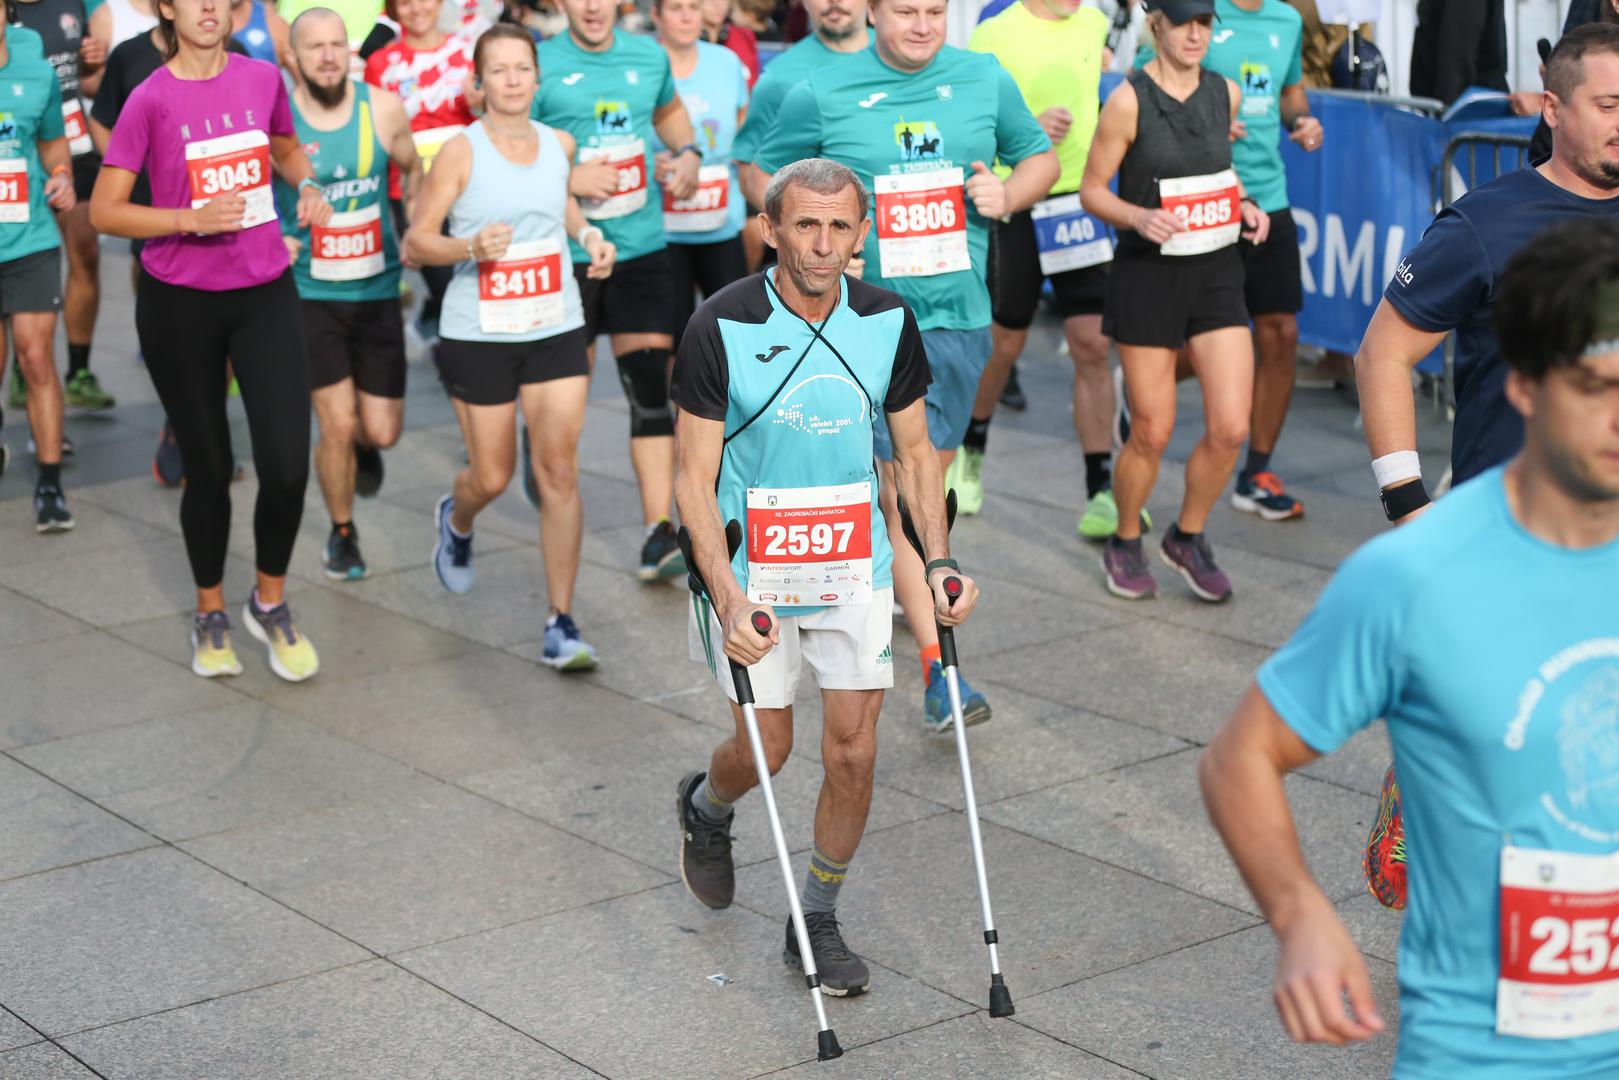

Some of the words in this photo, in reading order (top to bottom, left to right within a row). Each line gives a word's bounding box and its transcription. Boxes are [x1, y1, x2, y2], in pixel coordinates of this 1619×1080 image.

[181, 110, 256, 140] NIKE
[0, 179, 18, 201] 91
[201, 159, 262, 194] 3043
[889, 199, 956, 233] 3806
[1055, 217, 1095, 245] 440
[321, 230, 375, 258] 3801
[1290, 208, 1404, 306] RMI
[490, 265, 551, 297] 3411
[819, 508, 846, 516] MARATON
[765, 521, 855, 556] 2597
[825, 564, 850, 572] GARMIN
[1528, 915, 1619, 975] 25
